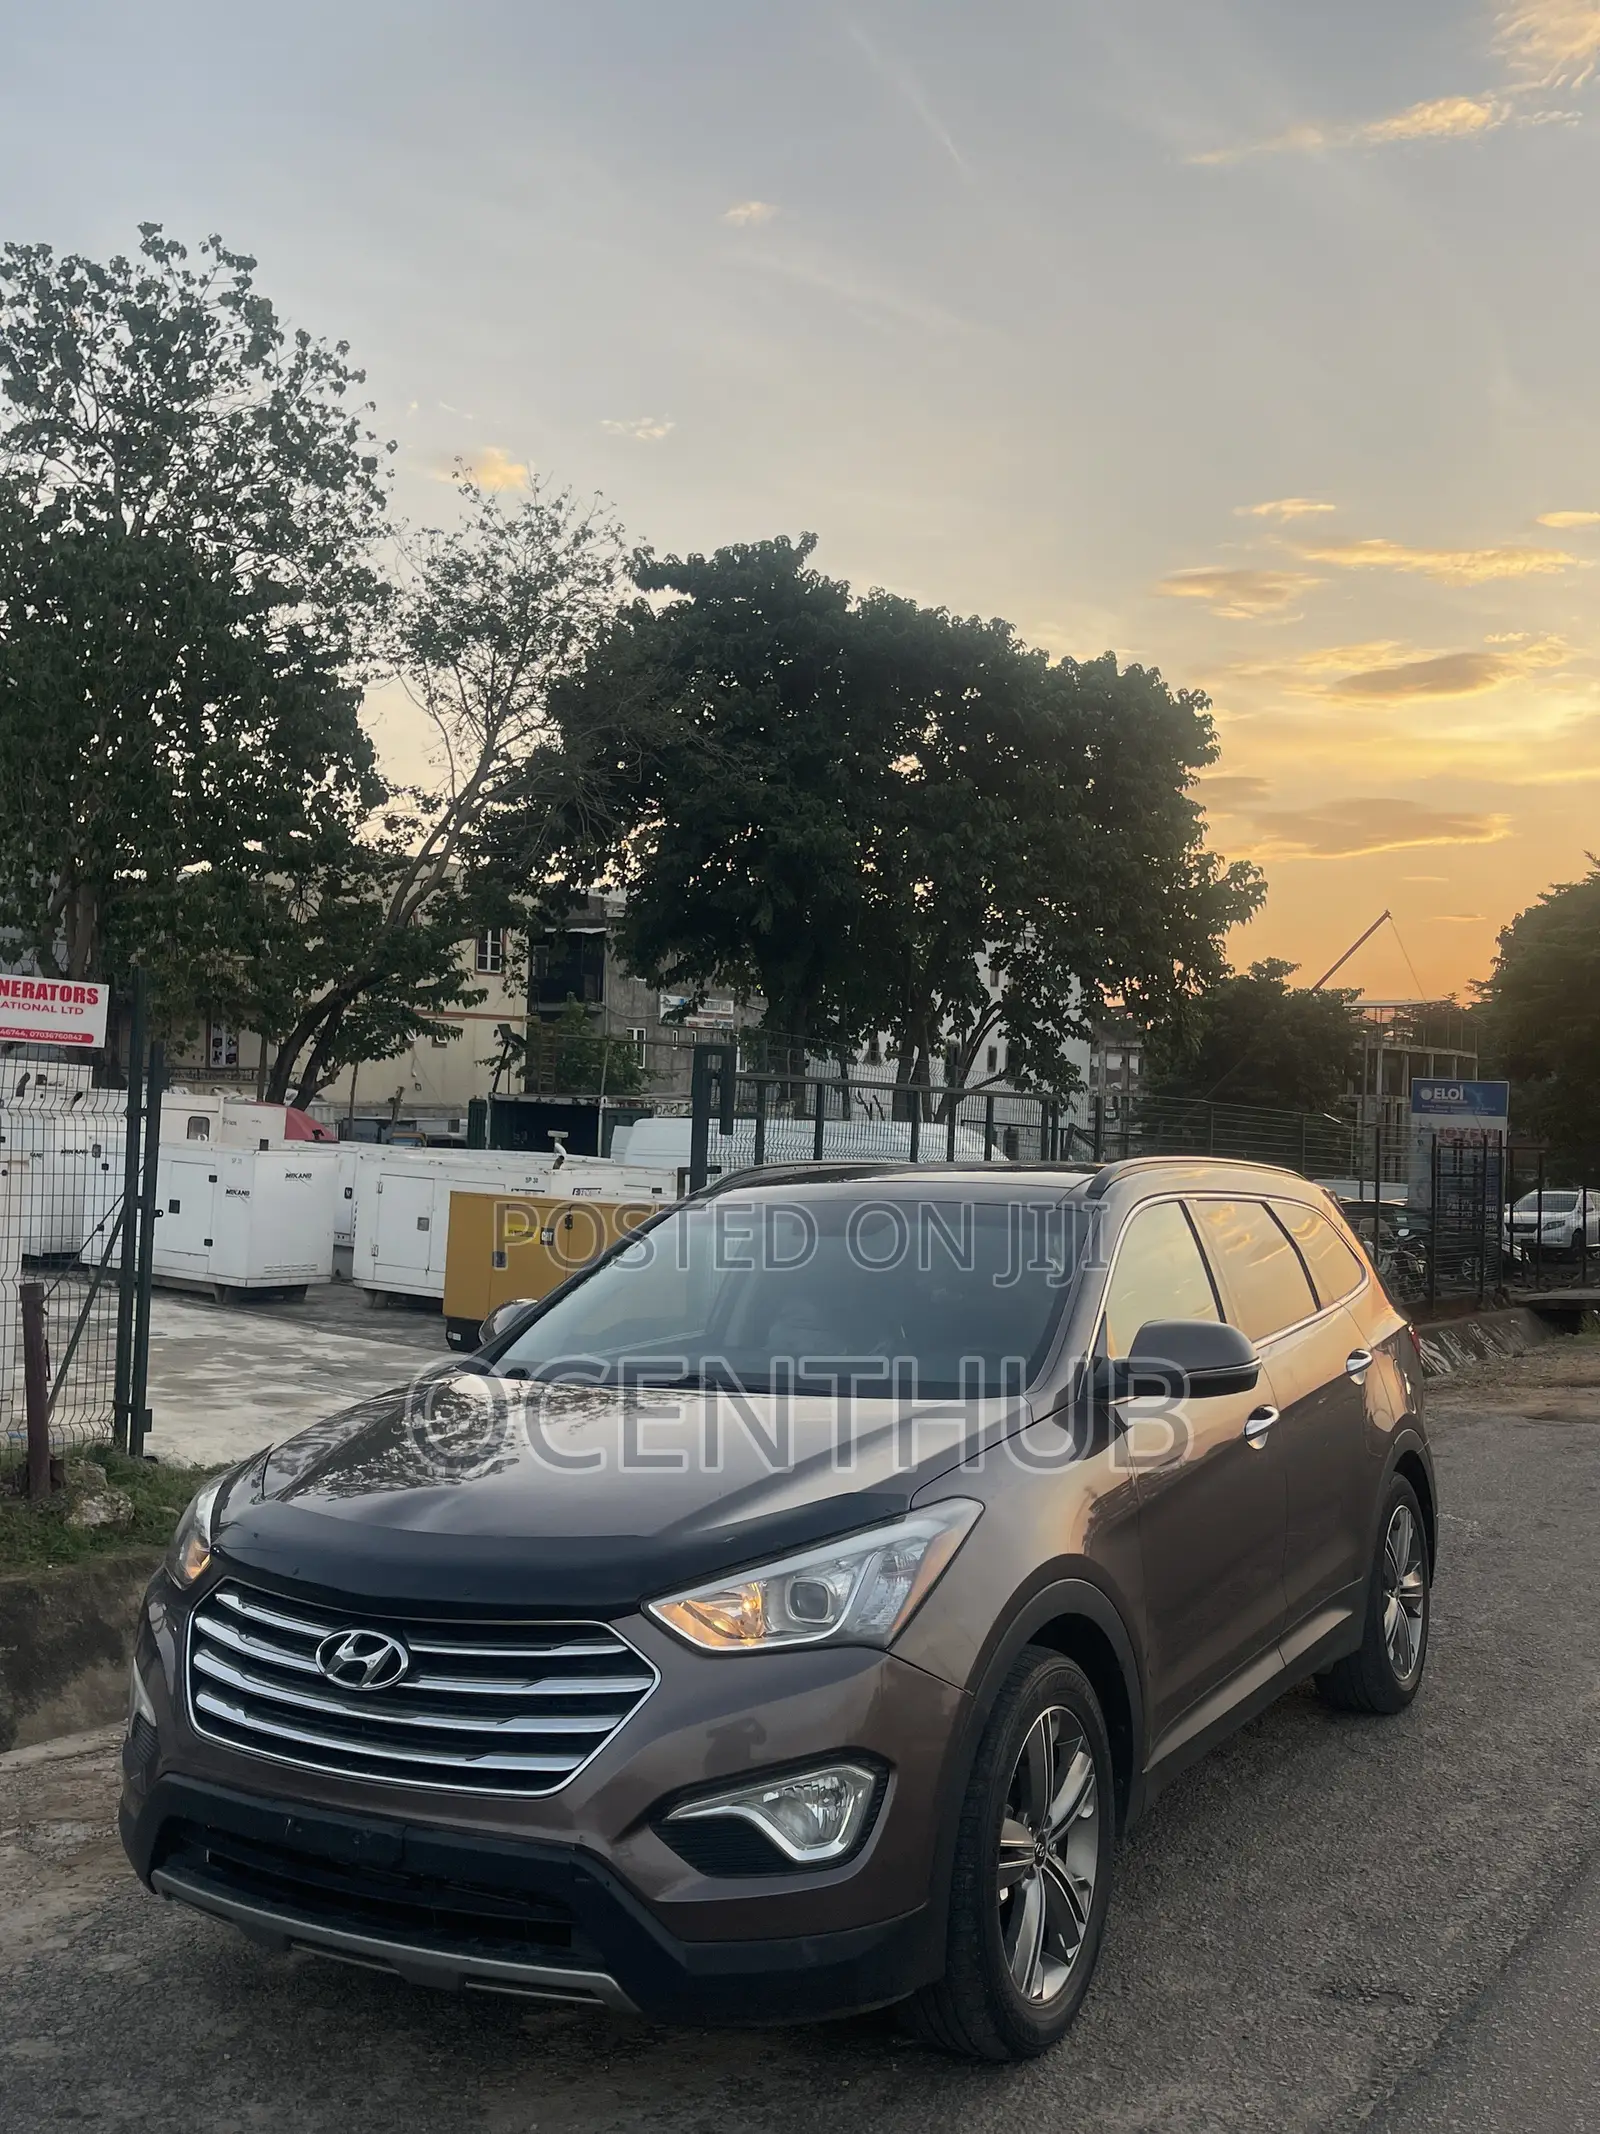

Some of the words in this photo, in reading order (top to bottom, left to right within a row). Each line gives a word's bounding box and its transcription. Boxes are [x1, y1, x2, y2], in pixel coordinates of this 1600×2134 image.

[0, 979, 99, 1005] NERATORS
[1, 1001, 57, 1013] ATIONAL
[61, 1006, 84, 1015] LTD
[226, 1188, 250, 1197] MIKANO
